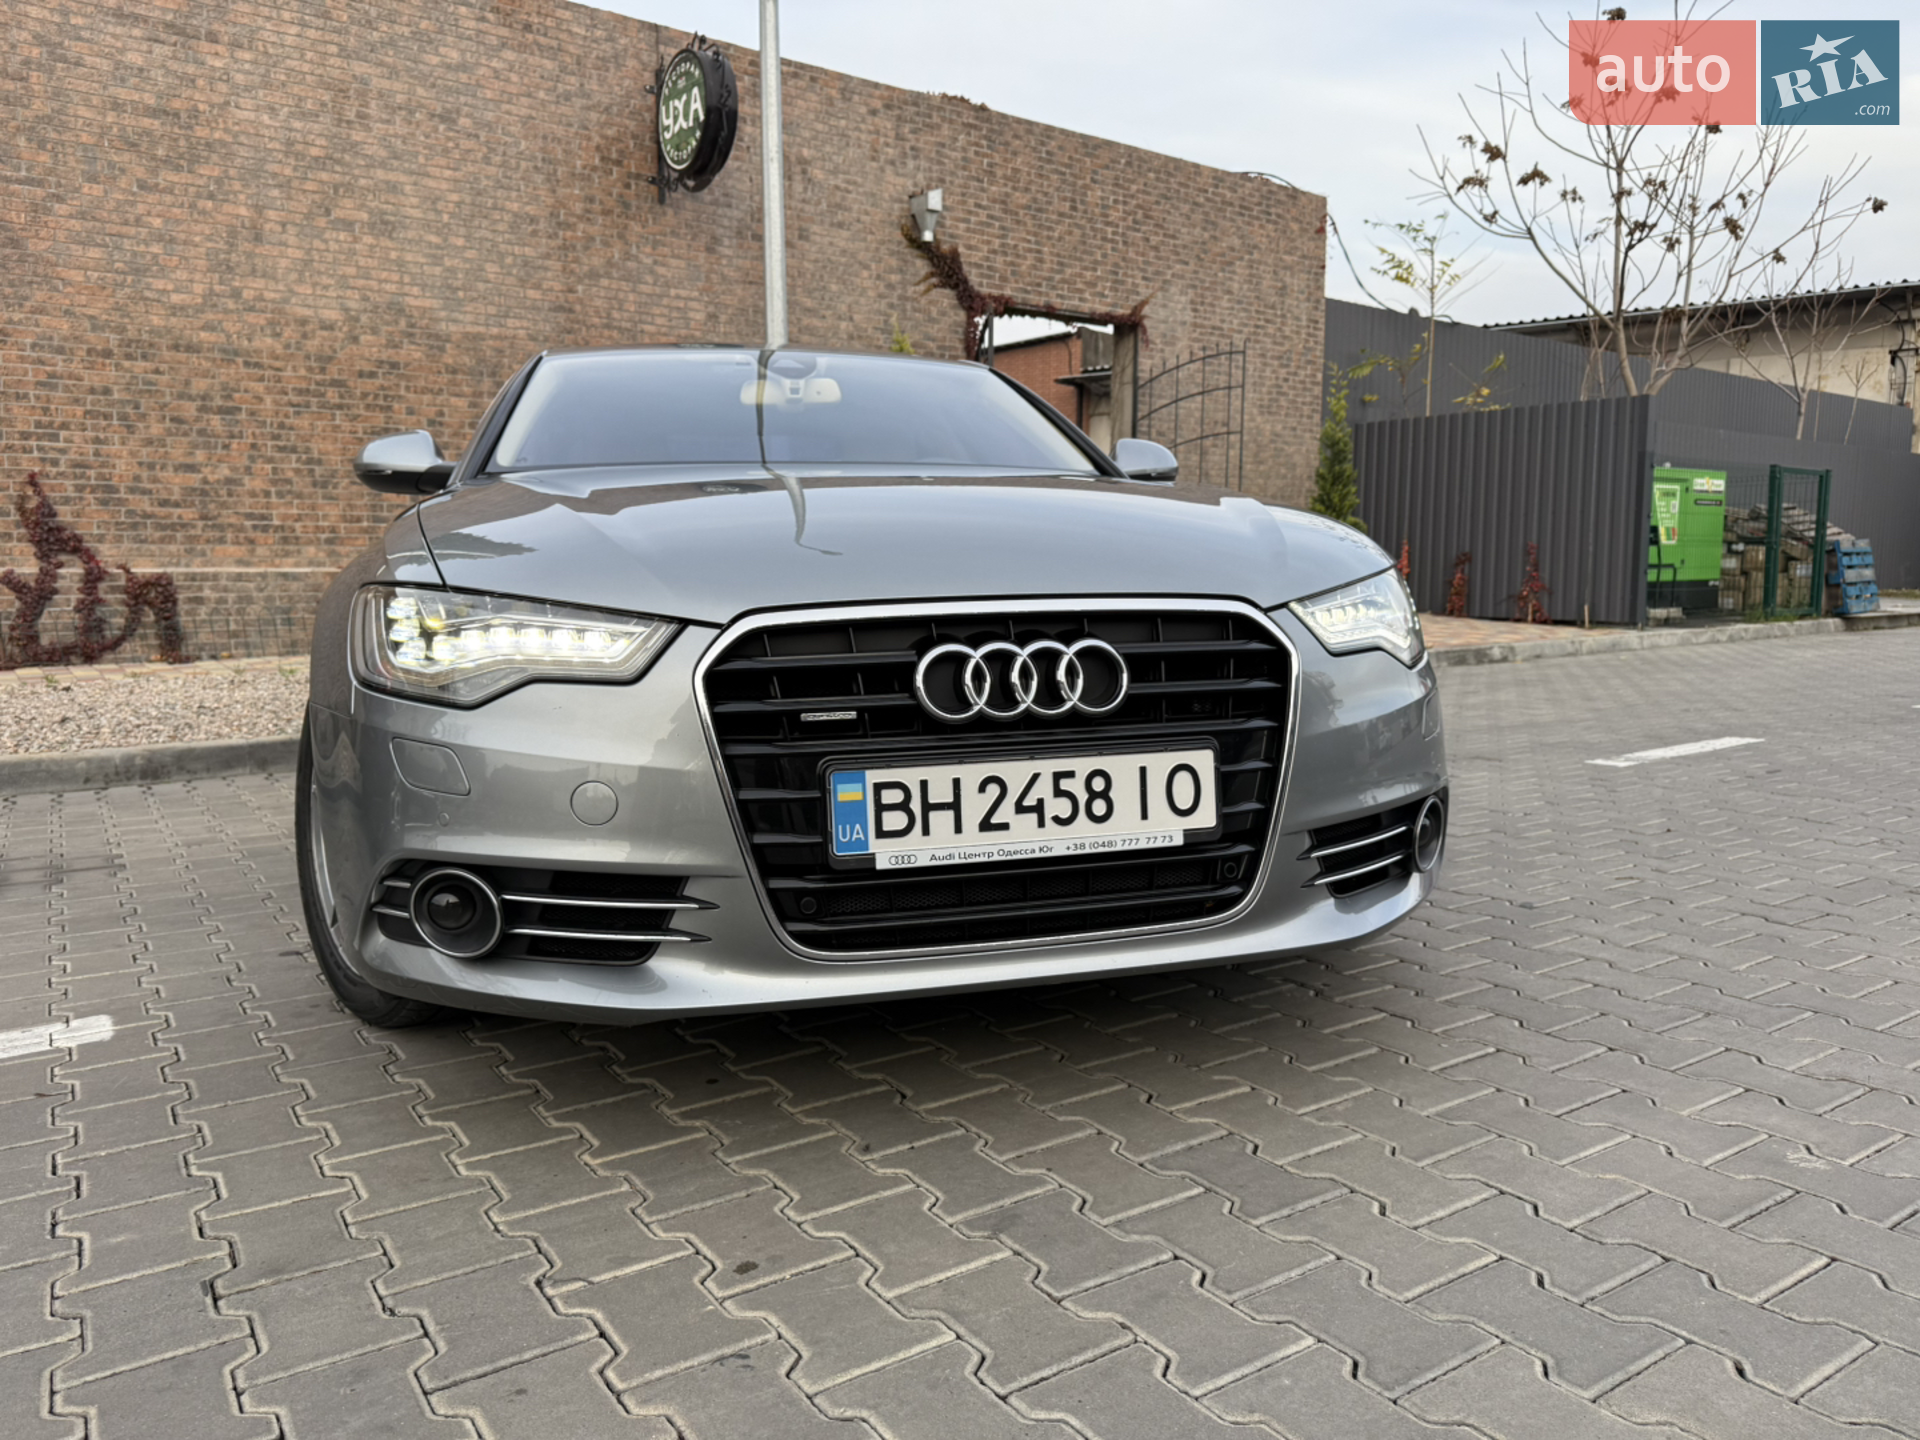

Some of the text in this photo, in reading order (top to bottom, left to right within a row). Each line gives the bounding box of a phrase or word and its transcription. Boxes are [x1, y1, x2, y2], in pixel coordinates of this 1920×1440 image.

[662, 86, 705, 140] УХА
[872, 763, 1202, 840] BH 2458 IO
[838, 823, 866, 843] UA
[928, 850, 956, 863] Audi
[957, 847, 995, 861] Центр
[996, 846, 1037, 858] Одесса
[1038, 844, 1055, 855] Юг
[1065, 841, 1087, 852] +38
[1088, 839, 1118, 851] (048)
[1120, 837, 1140, 847] 777
